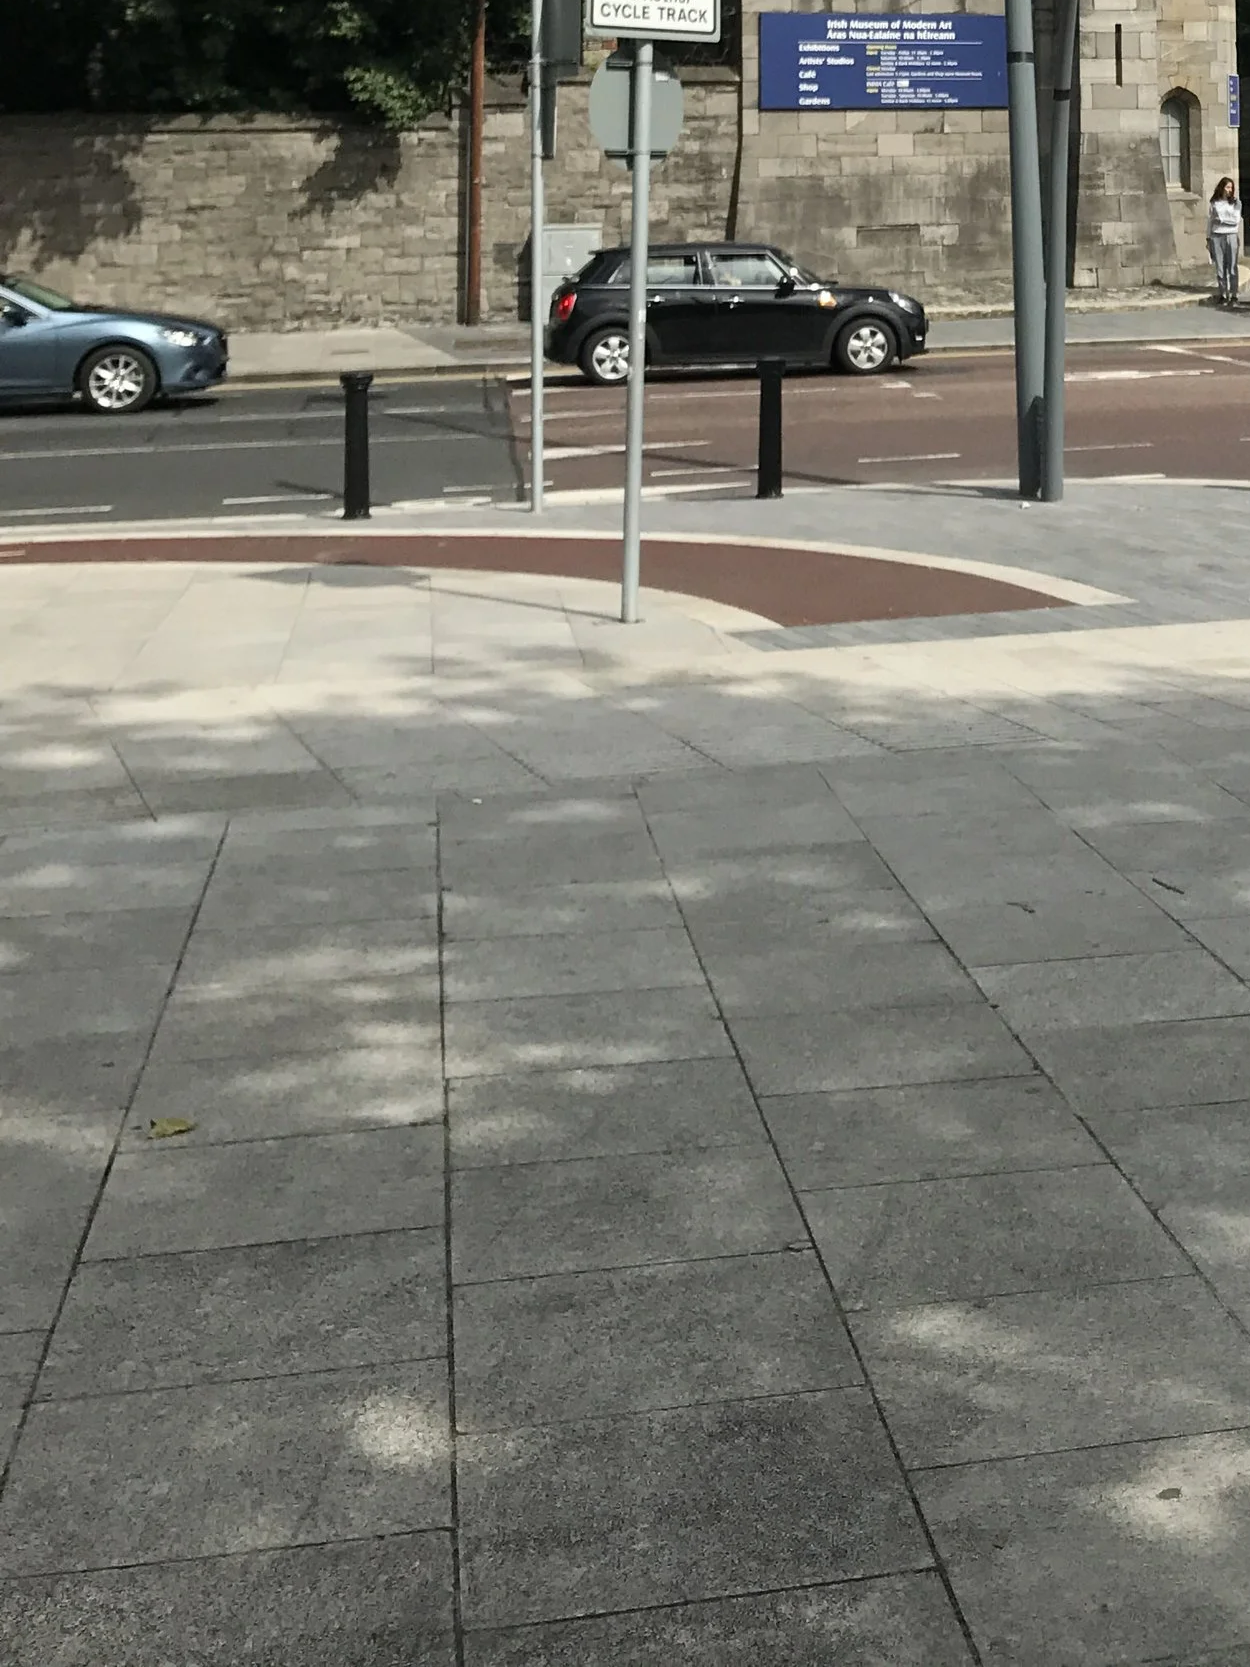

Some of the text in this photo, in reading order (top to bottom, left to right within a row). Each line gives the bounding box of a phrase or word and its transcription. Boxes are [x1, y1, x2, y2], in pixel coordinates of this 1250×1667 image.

[600, 2, 708, 24] CYCLE TRACK
[826, 19, 952, 30] Irish Museum of Modern Art
[903, 32, 915, 40] na
[798, 44, 840, 53] Exhibitions
[826, 56, 855, 66] Studios
[798, 70, 817, 79] Café
[798, 83, 819, 93] Shop
[798, 97, 831, 106] Gardens
